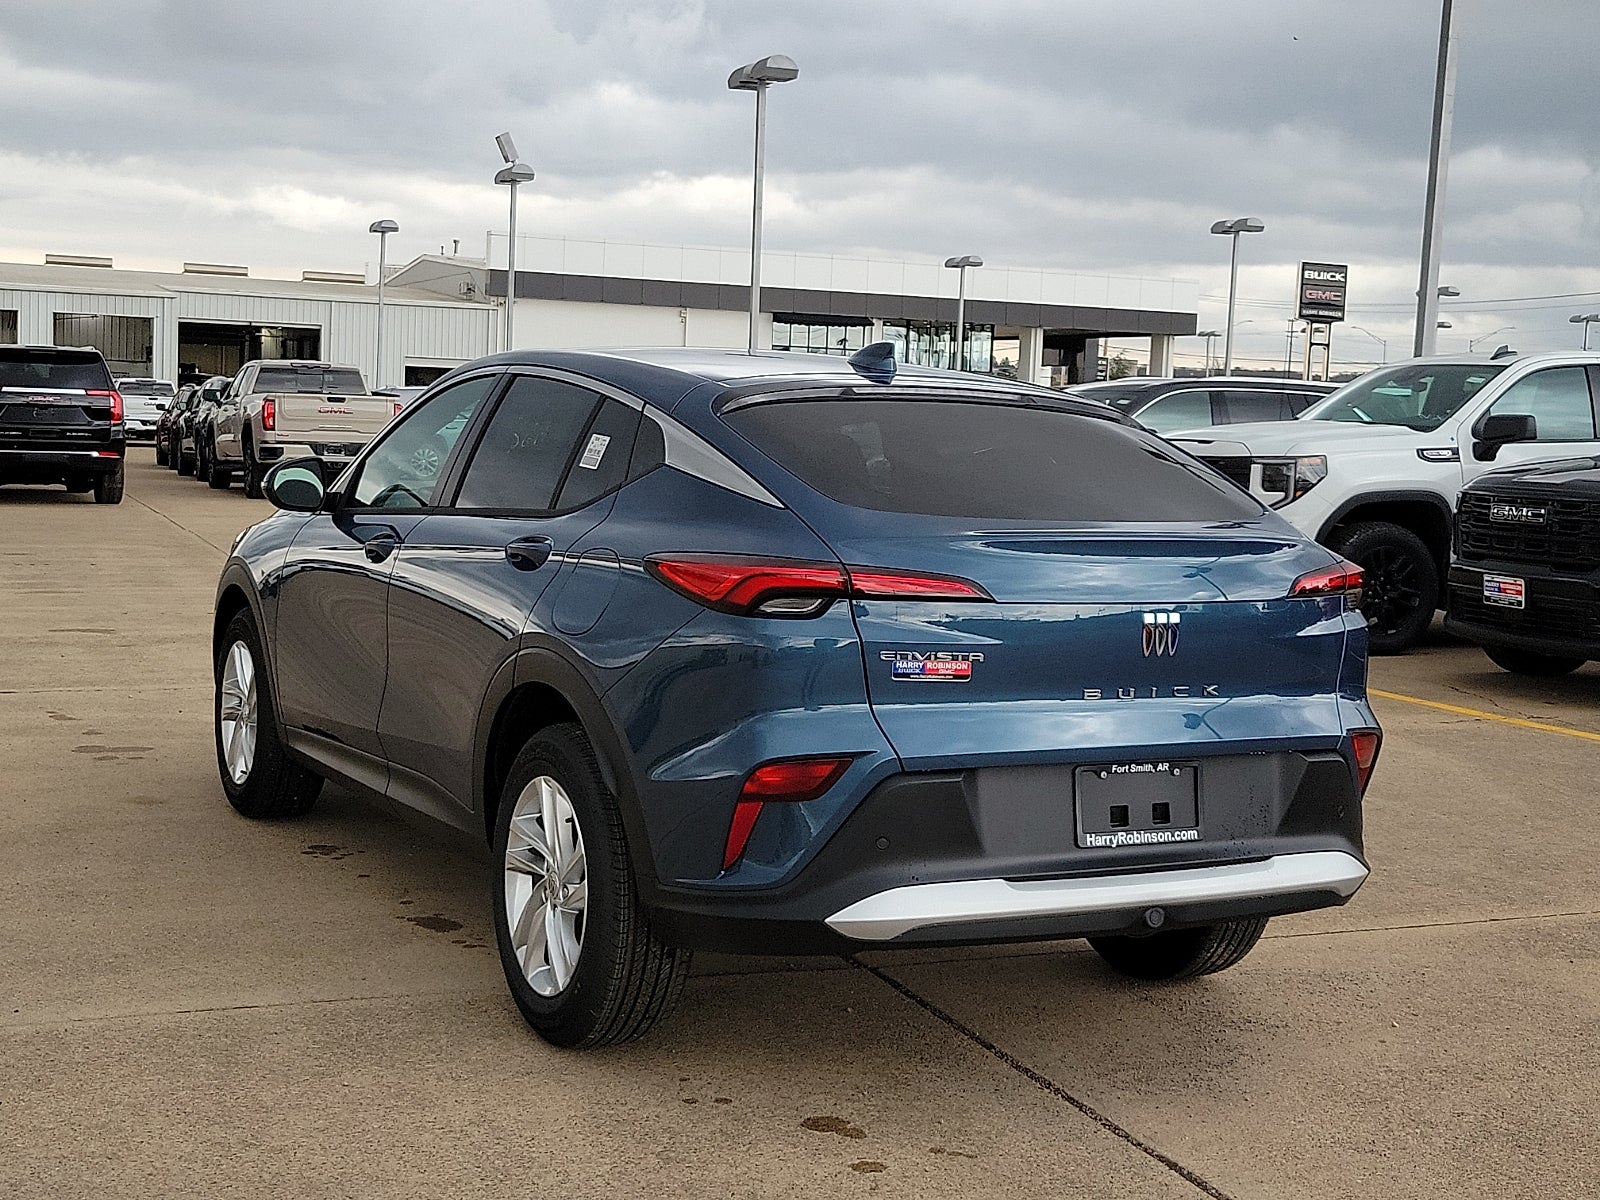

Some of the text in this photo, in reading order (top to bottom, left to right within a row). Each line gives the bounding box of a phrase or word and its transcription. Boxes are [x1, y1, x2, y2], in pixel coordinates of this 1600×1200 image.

[1304, 270, 1345, 282] BUICK
[1305, 289, 1342, 301] GMC
[318, 406, 354, 415] GMC
[1491, 504, 1545, 523] GMC
[896, 660, 968, 670] HARRY ROBINSON
[1082, 684, 1220, 700] BUICK
[1111, 762, 1170, 774] Fort Smith, AR
[1086, 829, 1199, 848] HarryRobinson.com
